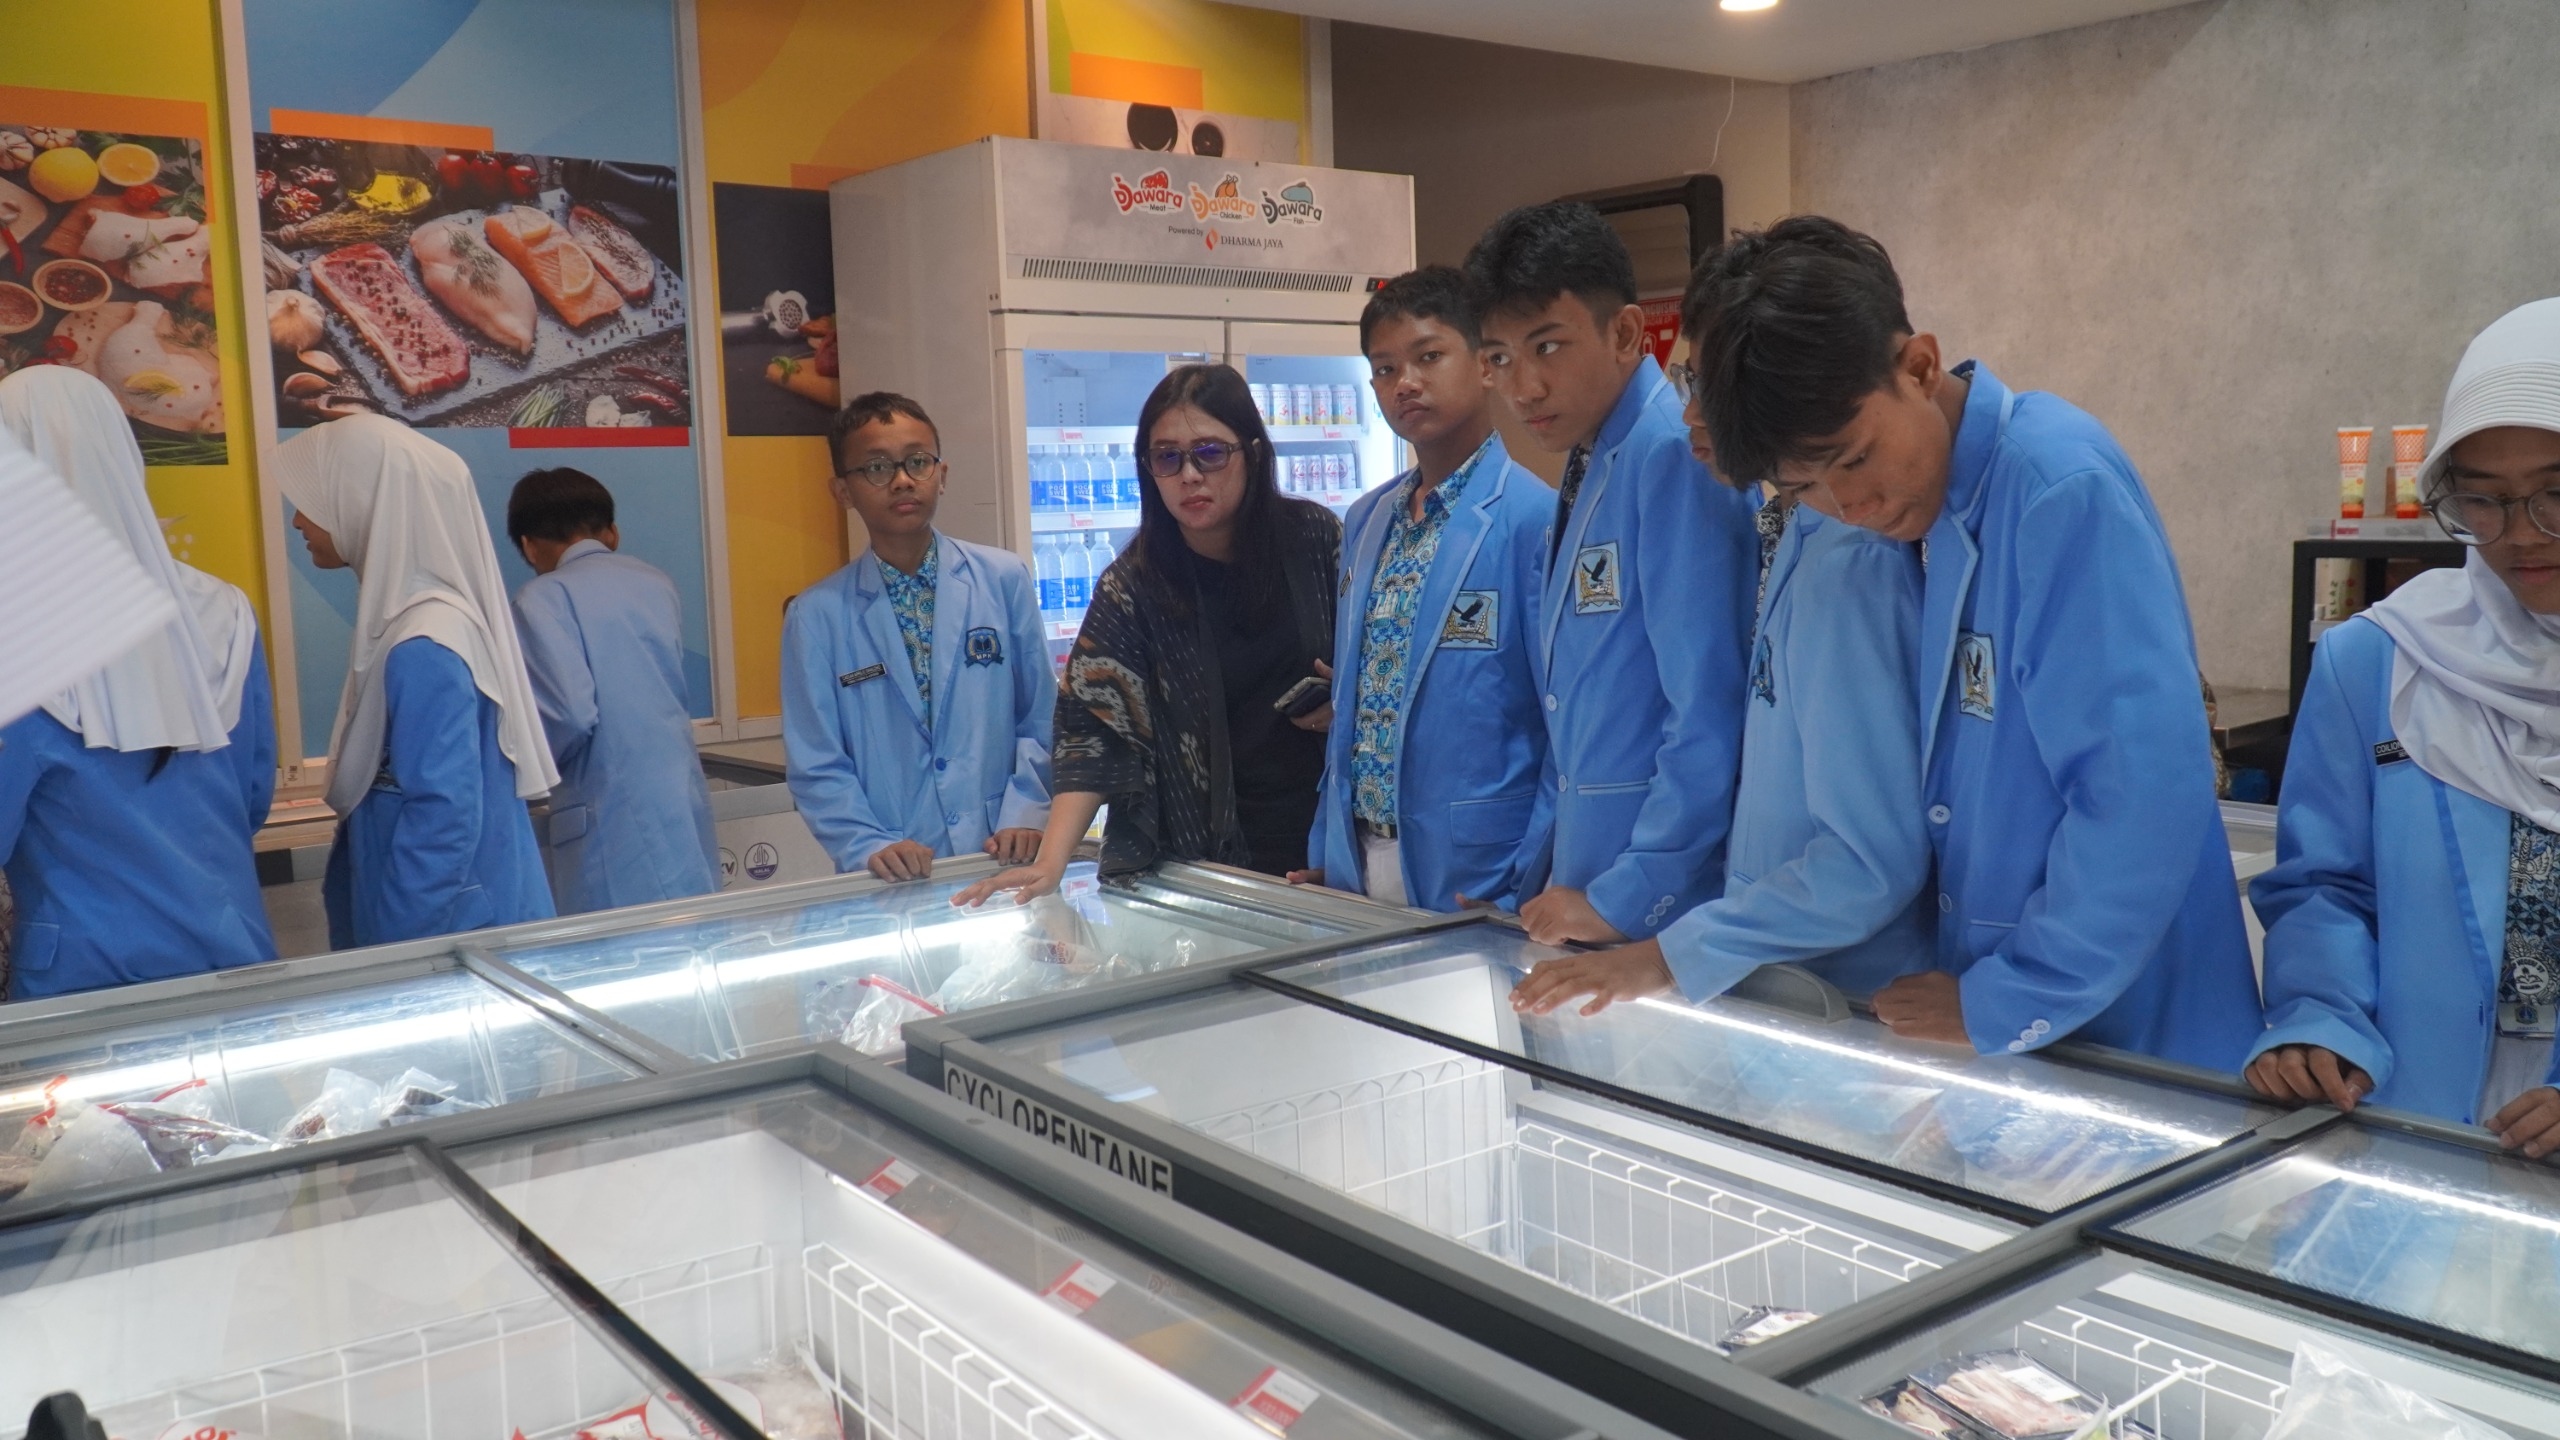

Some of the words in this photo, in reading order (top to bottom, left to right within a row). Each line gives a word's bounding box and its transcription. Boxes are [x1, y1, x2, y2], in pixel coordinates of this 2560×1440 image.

[1113, 176, 1183, 212] Dawara
[1149, 203, 1166, 212] Meat
[1190, 185, 1256, 220] Dawara
[1261, 190, 1323, 224] Dawara
[1219, 211, 1243, 221] Chicken
[1293, 217, 1305, 225] Fish
[1168, 226, 1195, 235] Powered
[1196, 228, 1204, 237] by
[1220, 235, 1262, 247] DHARMA
[1263, 238, 1284, 249] JAYA
[947, 1067, 1169, 1193] CYCLOPENTANE
